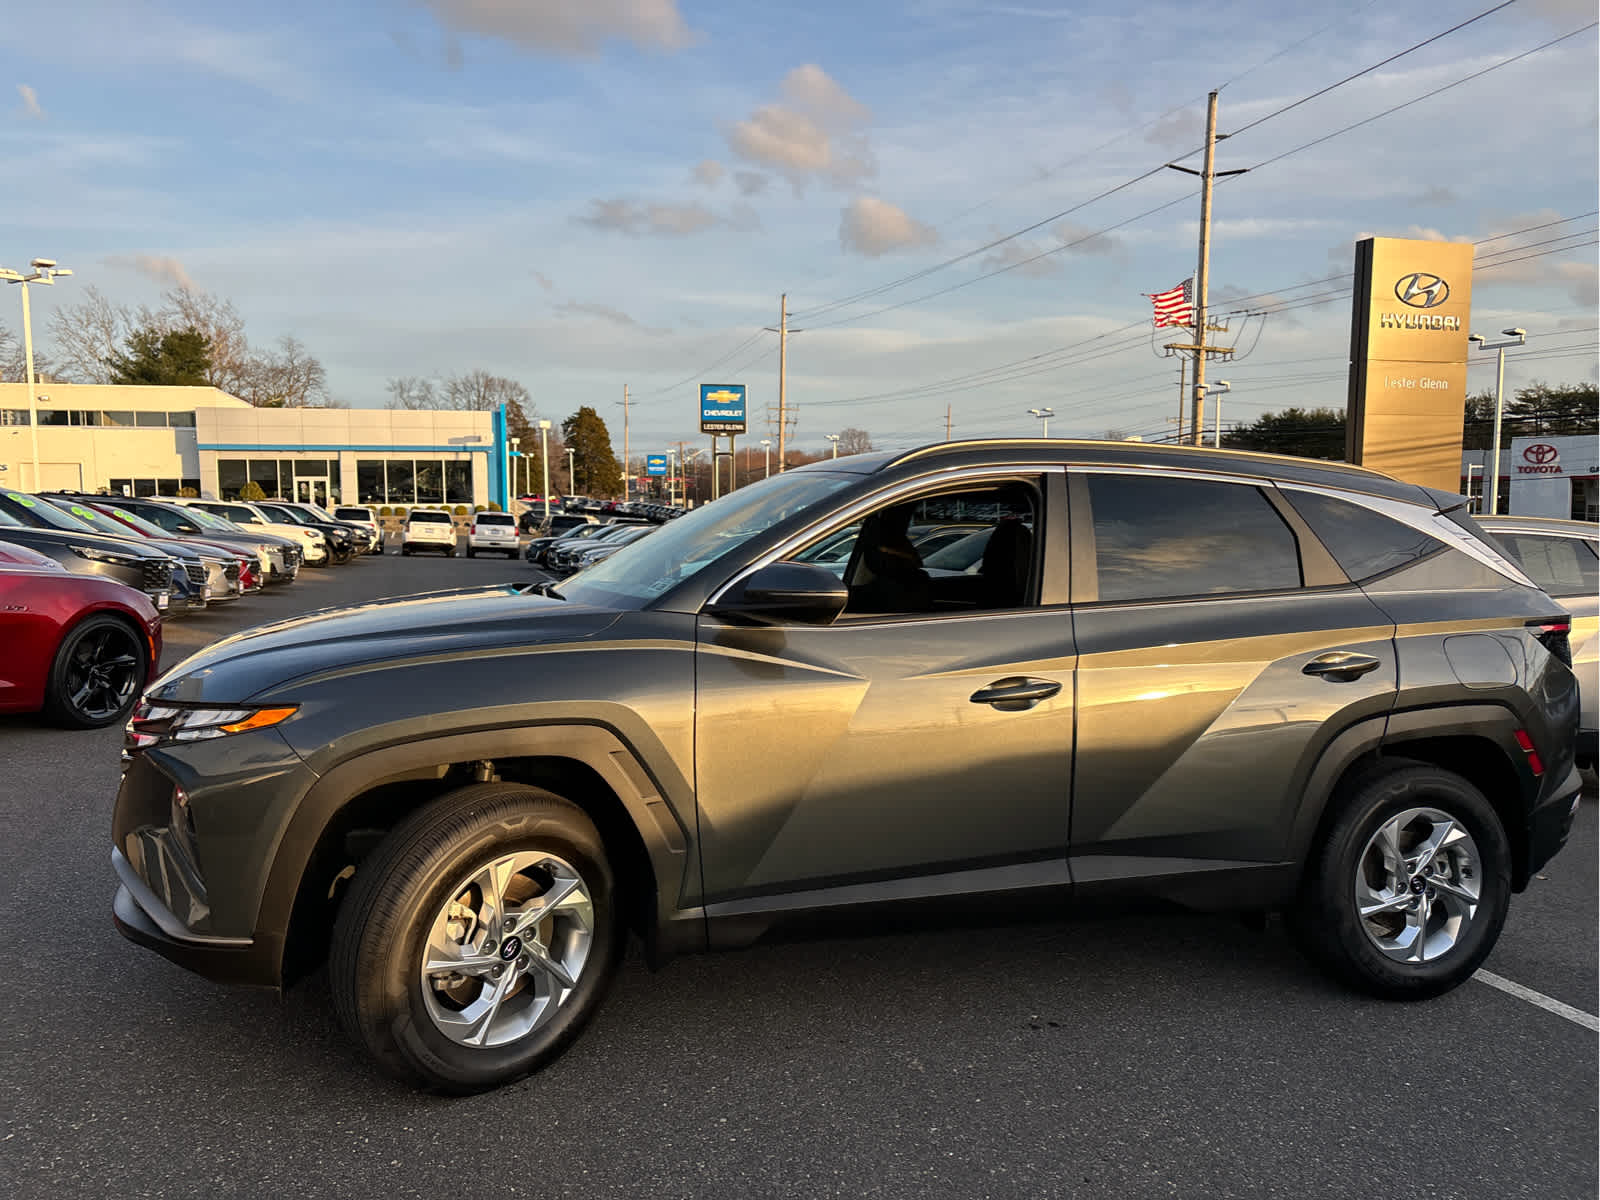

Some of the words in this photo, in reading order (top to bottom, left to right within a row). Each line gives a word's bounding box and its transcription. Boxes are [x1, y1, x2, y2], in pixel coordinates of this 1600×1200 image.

[1380, 312, 1460, 331] HYUNDAI
[1384, 375, 1416, 389] Lester
[1420, 376, 1449, 390] Glenn
[703, 409, 743, 417] CHEVROLET
[1517, 465, 1563, 474] TOYOTA
